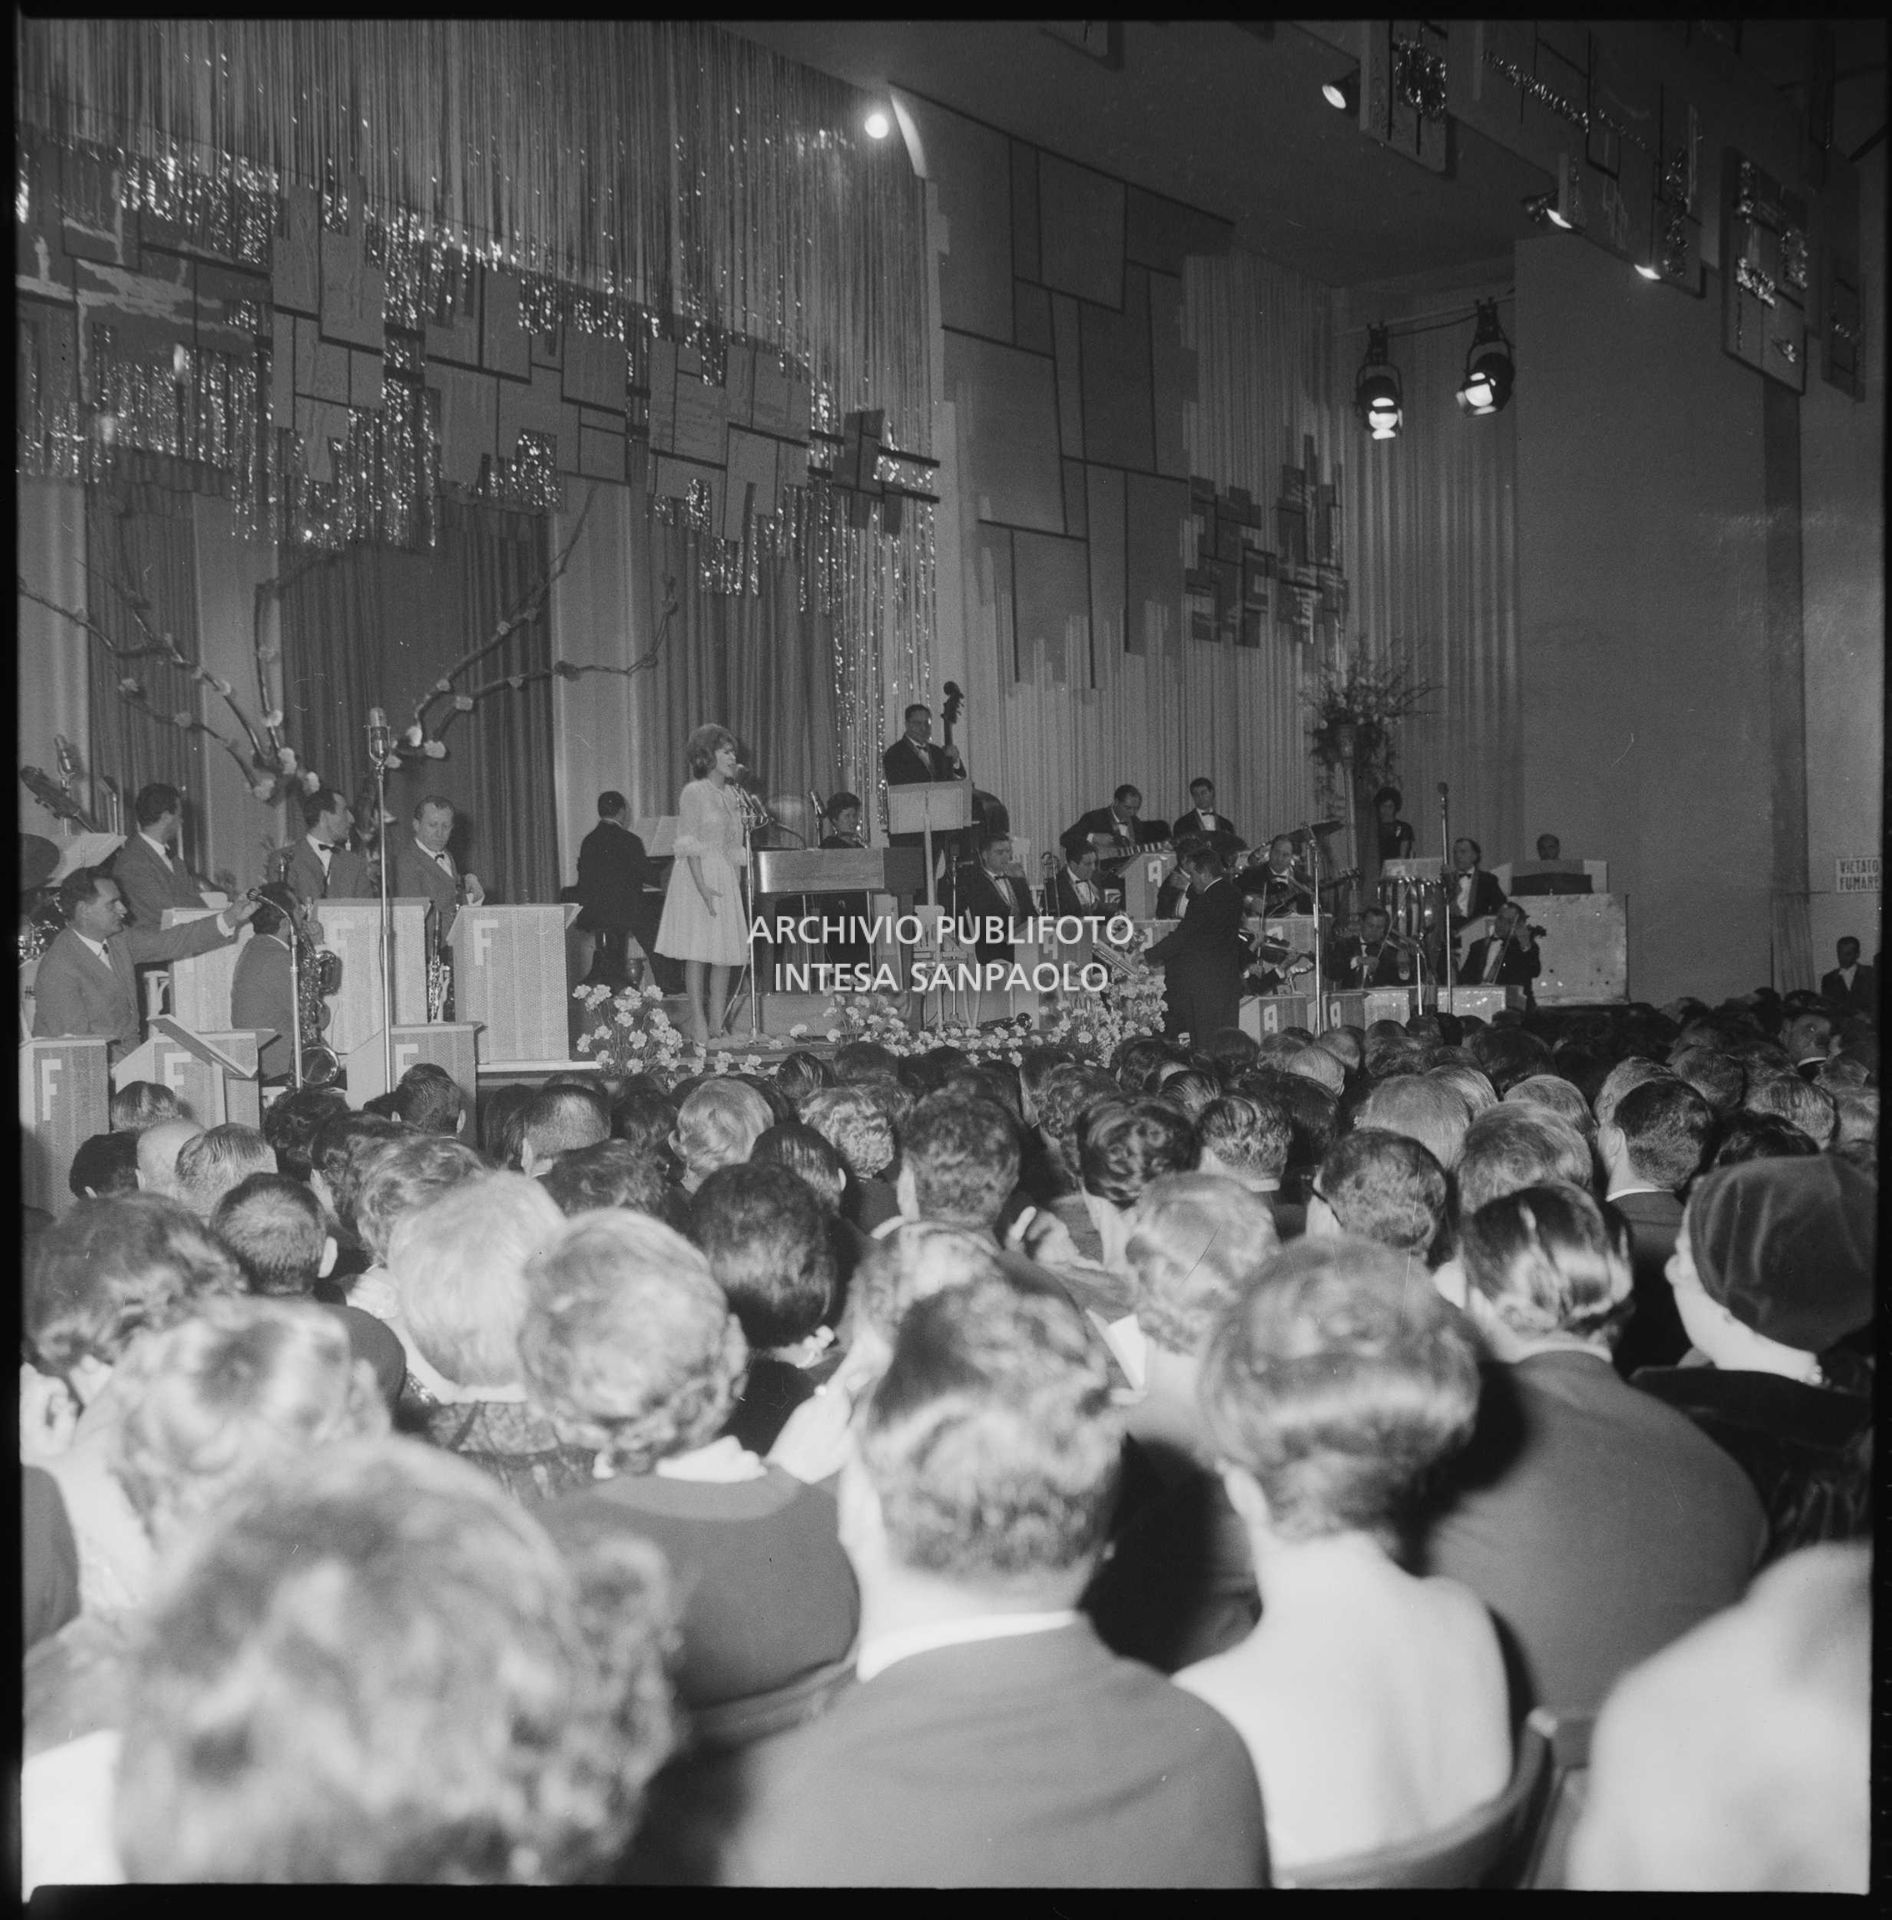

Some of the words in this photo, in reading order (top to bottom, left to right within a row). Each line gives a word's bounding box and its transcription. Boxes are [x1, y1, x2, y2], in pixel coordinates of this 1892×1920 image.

[1840, 860, 1879, 873] VIETATO
[1840, 876, 1880, 890] FUMARE
[473, 920, 498, 966] F
[1263, 1004, 1278, 1034] A
[1330, 1001, 1341, 1029] A
[164, 1052, 192, 1094] F
[396, 1044, 418, 1085] F
[41, 1059, 62, 1121] F
